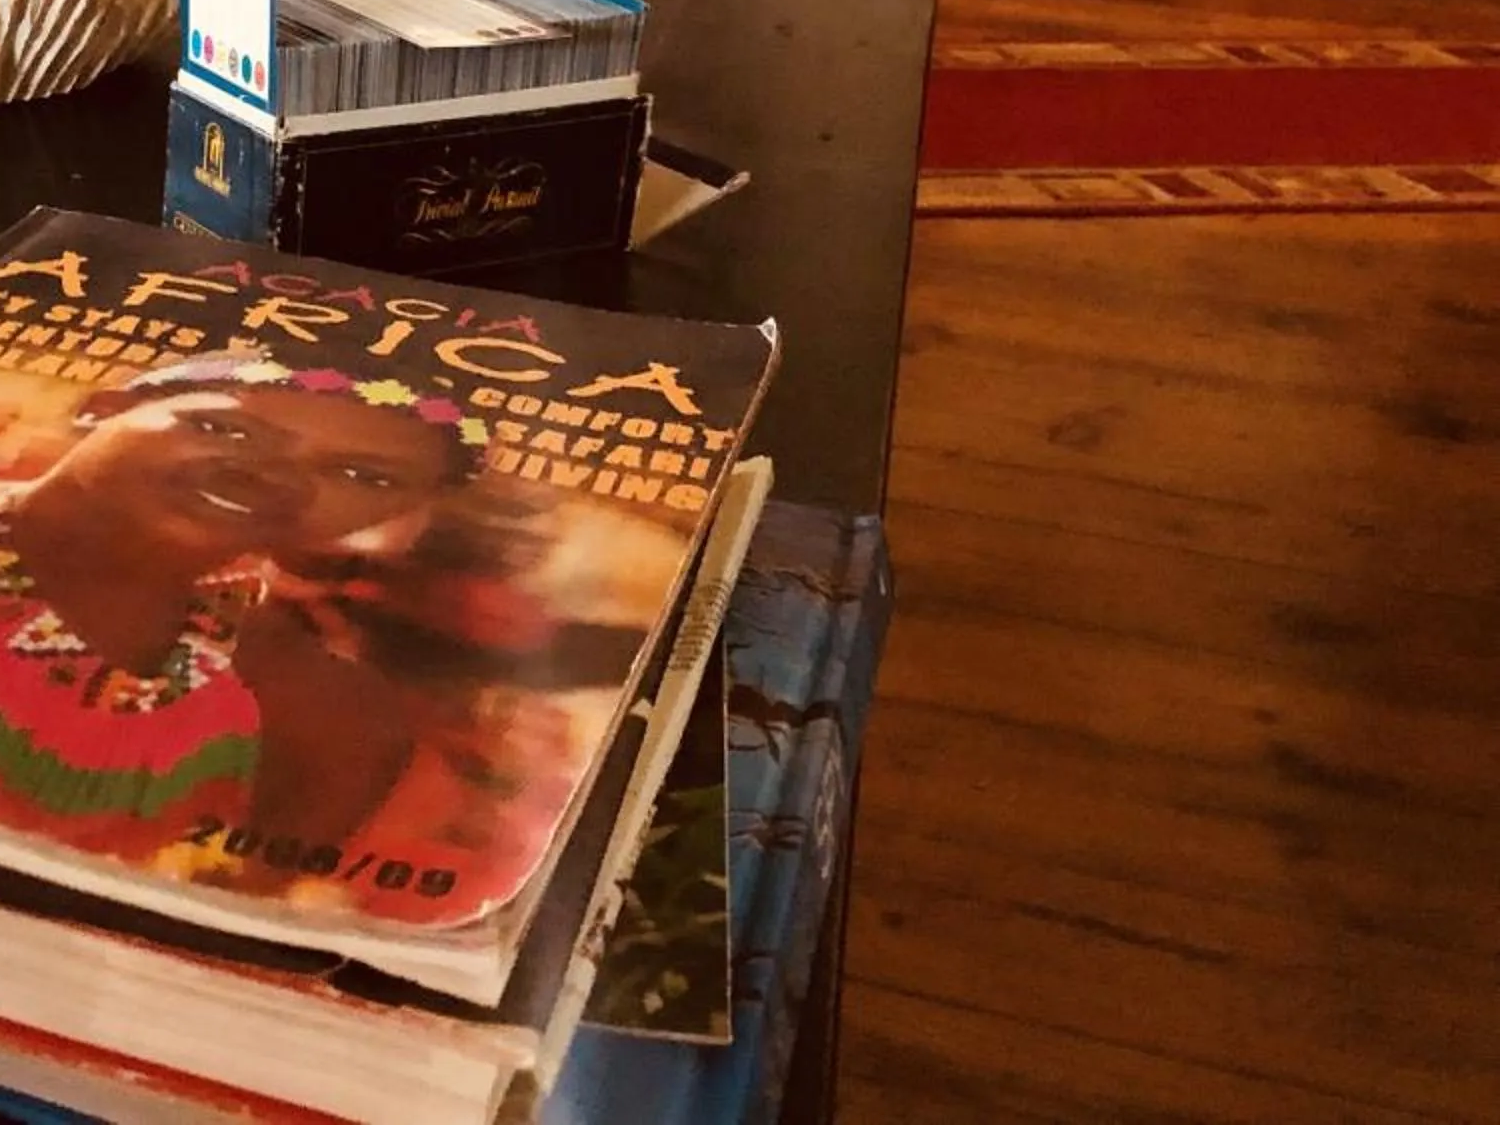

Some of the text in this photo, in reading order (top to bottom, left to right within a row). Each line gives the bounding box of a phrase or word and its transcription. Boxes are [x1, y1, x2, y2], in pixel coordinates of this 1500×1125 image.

[43, 304, 207, 349] STAYS
[188, 259, 542, 344] ACACIA
[469, 387, 736, 452] COMFORT
[494, 419, 712, 479] SAFARI
[485, 446, 710, 512] DIVING
